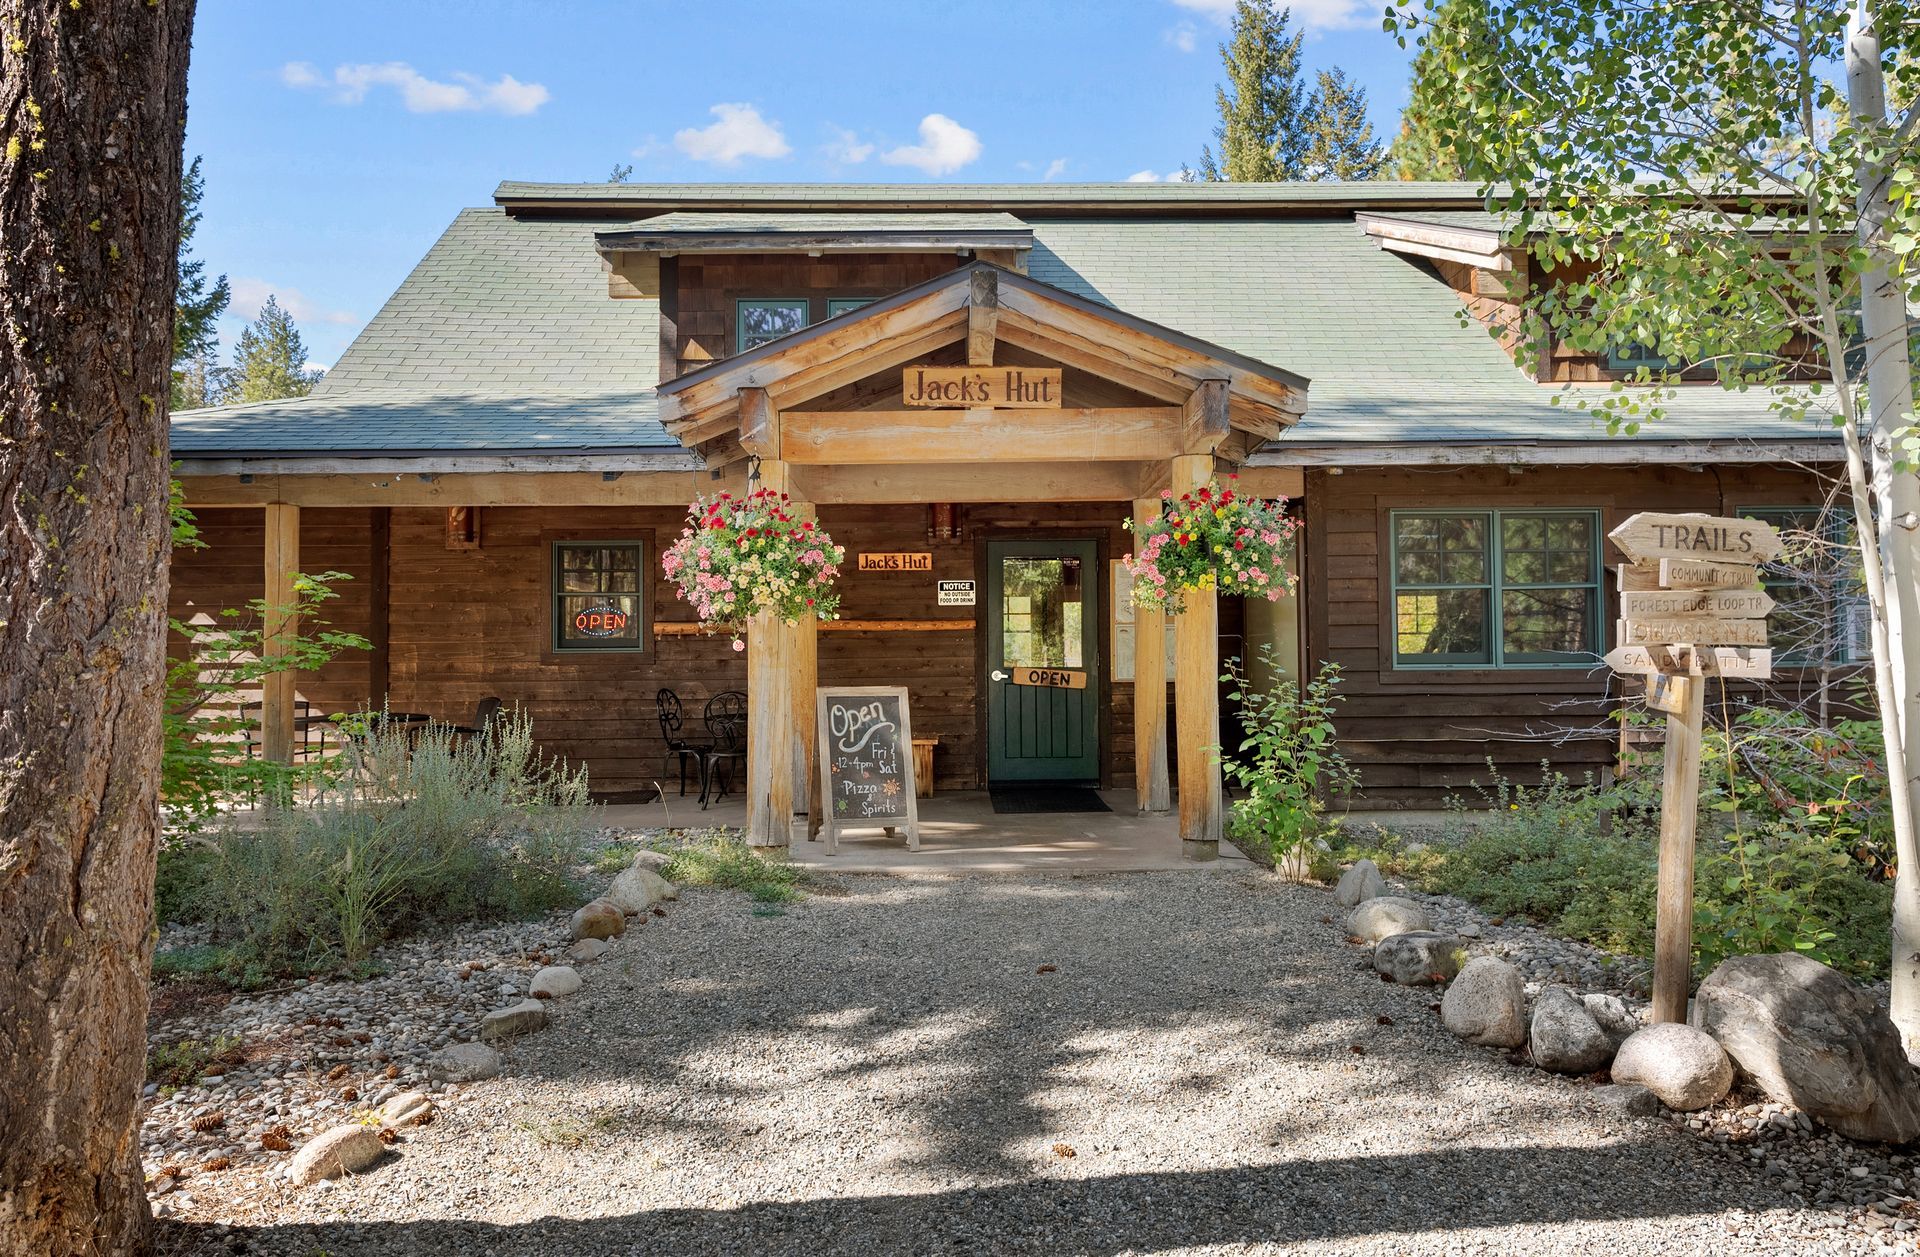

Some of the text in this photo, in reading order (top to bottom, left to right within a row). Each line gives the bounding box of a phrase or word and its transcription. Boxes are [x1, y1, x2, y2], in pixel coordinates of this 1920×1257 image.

[909, 370, 1053, 402] Jack's Hut
[1651, 524, 1753, 553] TRAILS
[861, 555, 928, 569] Jack's Hut
[1671, 567, 1727, 585] COMMUNITY
[943, 583, 971, 591] NOTICE
[1631, 597, 1767, 613] FOREST EDGE LOOP TR.
[575, 614, 626, 630] OPEN
[1624, 653, 1757, 669] SANDY BUTTE
[1029, 669, 1071, 686] OPEN
[830, 702, 887, 742] Open
[872, 742, 887, 759] Fri
[879, 761, 898, 774] Sat
[843, 780, 878, 795] Pizza
[861, 800, 896, 817] Spirits
